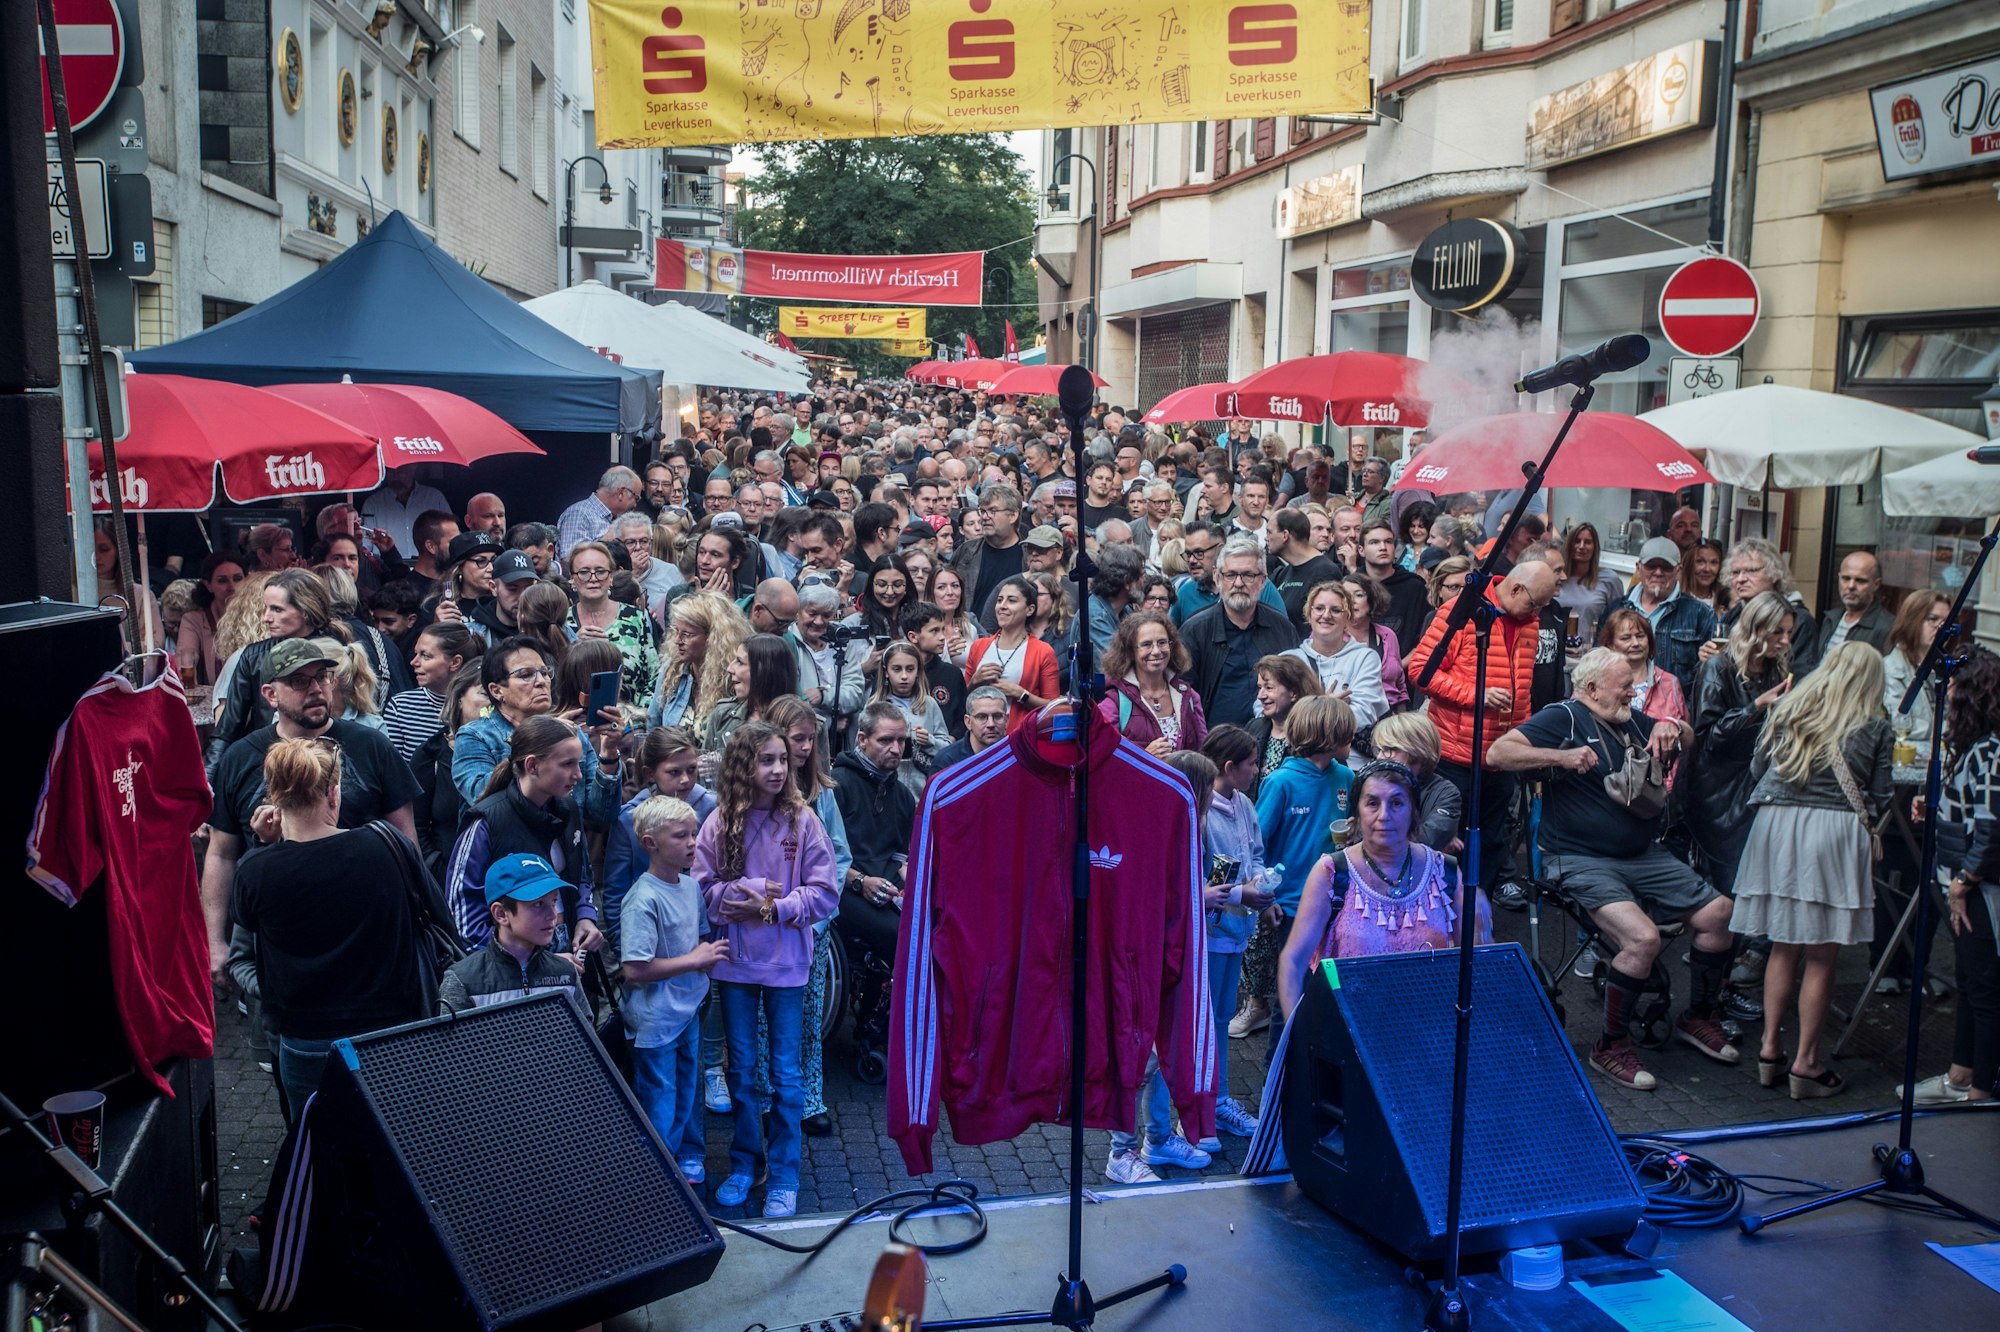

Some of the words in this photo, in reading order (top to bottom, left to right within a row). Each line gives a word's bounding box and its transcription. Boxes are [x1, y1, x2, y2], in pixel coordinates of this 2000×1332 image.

[1229, 70, 1298, 85] Sparkasse
[950, 86, 1016, 101] Sparkasse
[1226, 87, 1302, 103] Leverkusen
[646, 100, 709, 116] Sparkasse
[946, 102, 1020, 118] Leverkusen
[643, 117, 713, 132] Leverkusen
[1432, 239, 1482, 291] FELLINI
[818, 313, 858, 325] STREET
[860, 312, 885, 324] LIFE
[1268, 395, 1303, 419] früh
[1362, 402, 1401, 424] früh
[393, 435, 445, 452] früh
[409, 448, 437, 456] KÖLSCH
[265, 452, 325, 490] früh
[1415, 464, 1449, 481] früh
[1656, 460, 1697, 477] früh
[89, 466, 149, 508] rüh
[92, 1125, 100, 1153] zero
